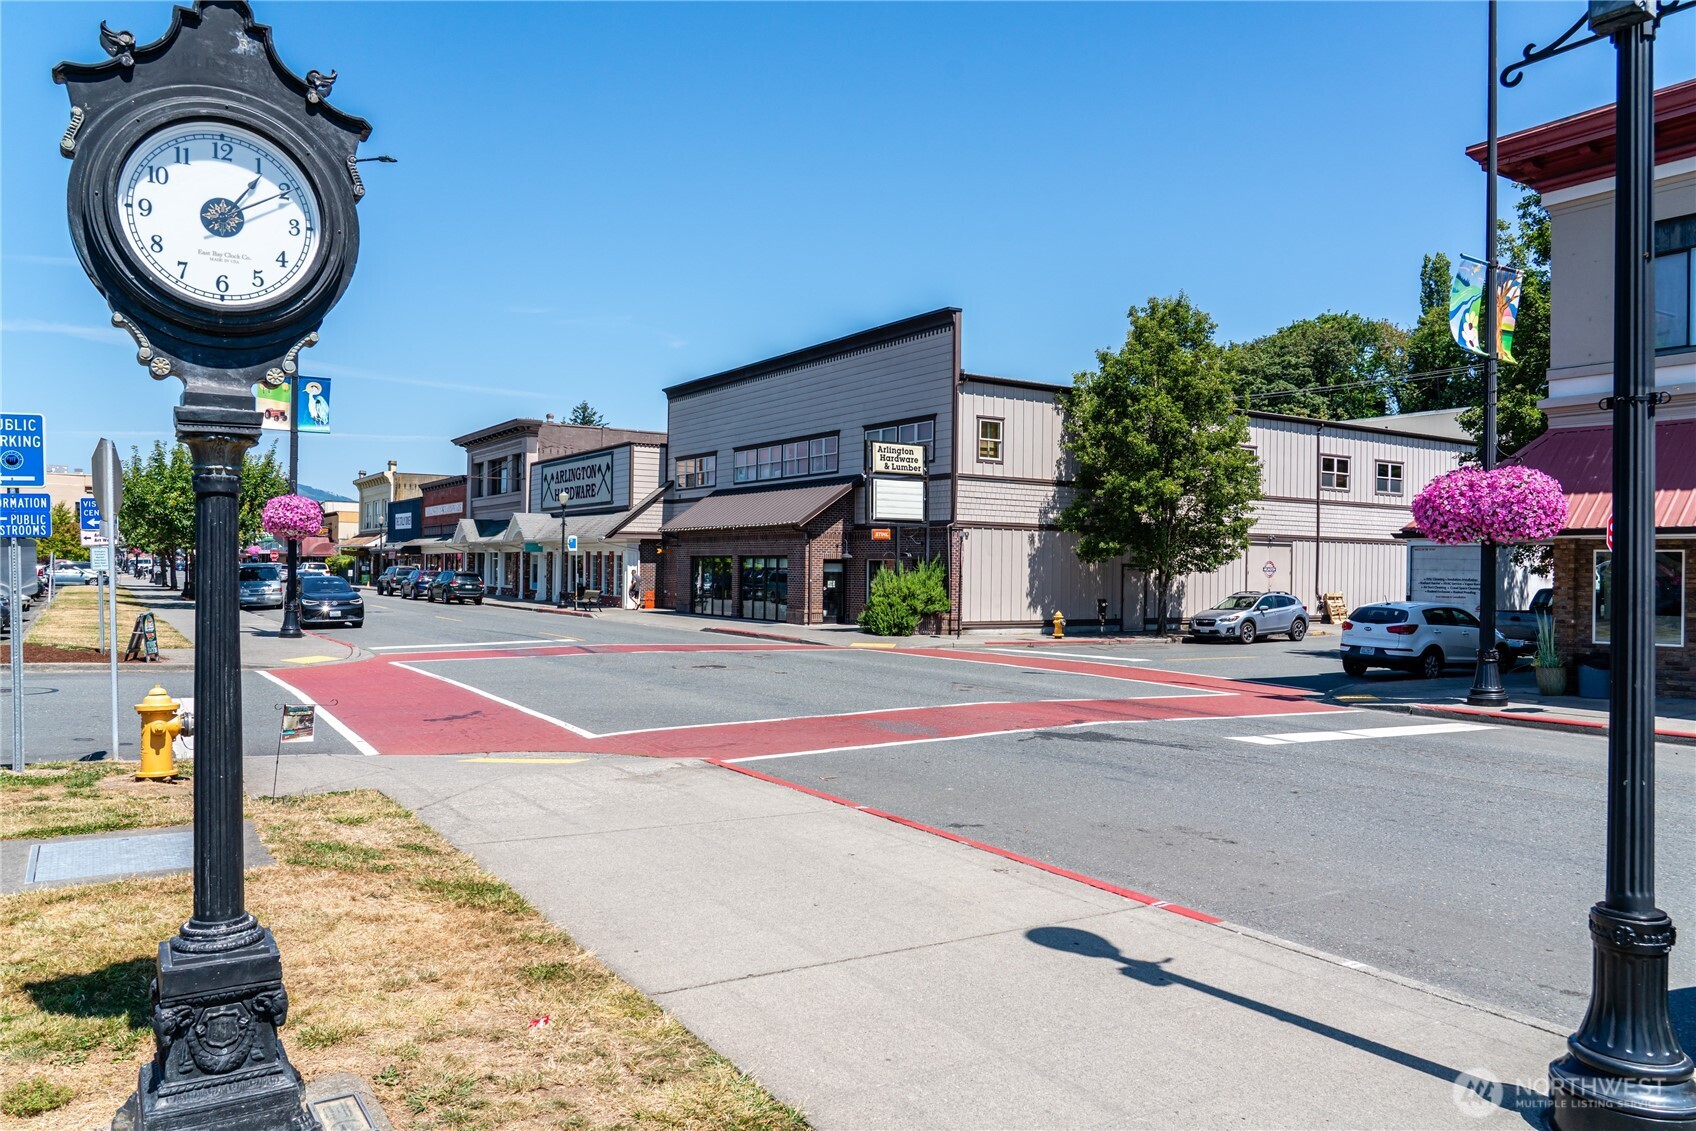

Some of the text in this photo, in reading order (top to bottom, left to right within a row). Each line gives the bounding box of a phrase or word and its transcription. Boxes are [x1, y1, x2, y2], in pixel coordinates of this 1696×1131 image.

[174, 146, 191, 165] 11
[211, 141, 234, 162] 12
[147, 165, 169, 185] 10
[255, 157, 263, 175] 1
[278, 182, 291, 201] 2
[138, 198, 152, 217] 9
[288, 218, 300, 236] 3
[150, 234, 163, 253] 8
[197, 248, 211, 256] East
[212, 250, 223, 258] Bay
[224, 252, 240, 260] Clock
[275, 250, 288, 268] 4
[176, 260, 188, 279] 7
[251, 269, 264, 287] 5
[216, 274, 229, 293] 6
[0, 418, 36, 431] BLIC
[0, 435, 41, 448] RKING
[877, 445, 914, 457] Arlington
[880, 453, 919, 464] Hardware
[555, 463, 597, 485] ARLINGTON
[884, 462, 921, 472] & Lumber
[0, 497, 47, 508] RMATION
[11, 514, 46, 525] PUBLIC
[0, 525, 47, 536] STROOMS
